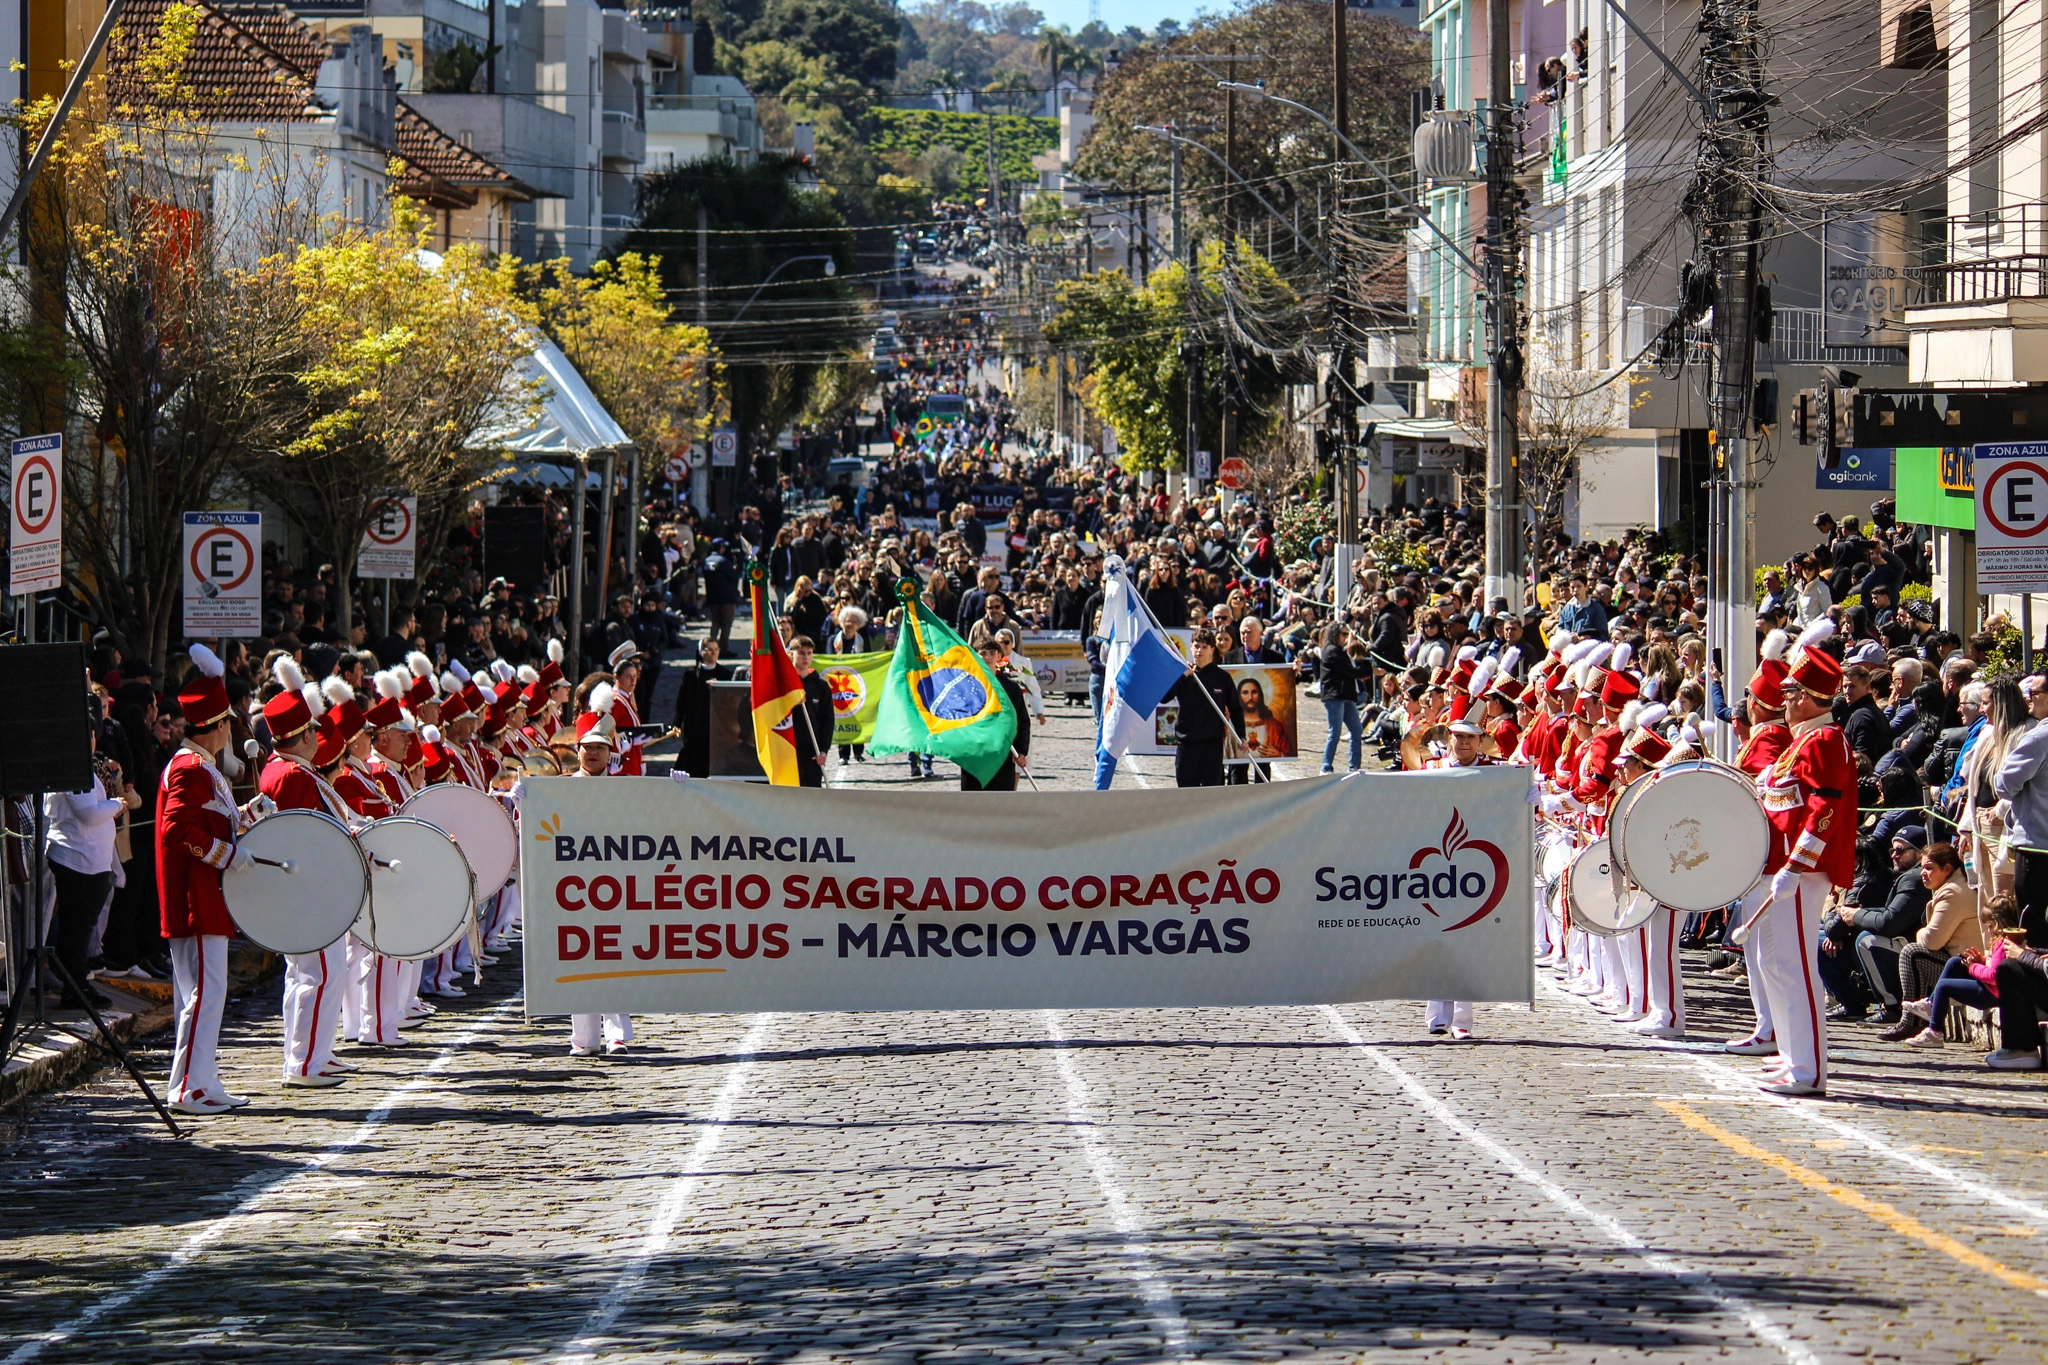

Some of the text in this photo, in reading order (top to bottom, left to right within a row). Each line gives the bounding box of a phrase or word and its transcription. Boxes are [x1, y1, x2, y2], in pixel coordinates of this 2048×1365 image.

[19, 438, 53, 452] ZONA AZUL
[1989, 445, 2048, 456] ZONA AZUL
[28, 471, 43, 518] E
[2007, 477, 2035, 522] E
[197, 514, 248, 523] ZONA AZUL
[379, 508, 396, 535] E
[211, 541, 233, 577] E
[555, 835, 855, 863] BANDA MARCIAL
[555, 859, 1281, 914] COLÉGIO SAGRADO CORAÇÃO
[1314, 865, 1486, 910] Sagrado
[558, 924, 622, 960] DE
[632, 923, 790, 960] JESUS
[838, 913, 1037, 958] MÁRCIO
[1046, 917, 1251, 956] VARGAS
[1318, 915, 1421, 929] REDE DE EDUCAÇÃO
